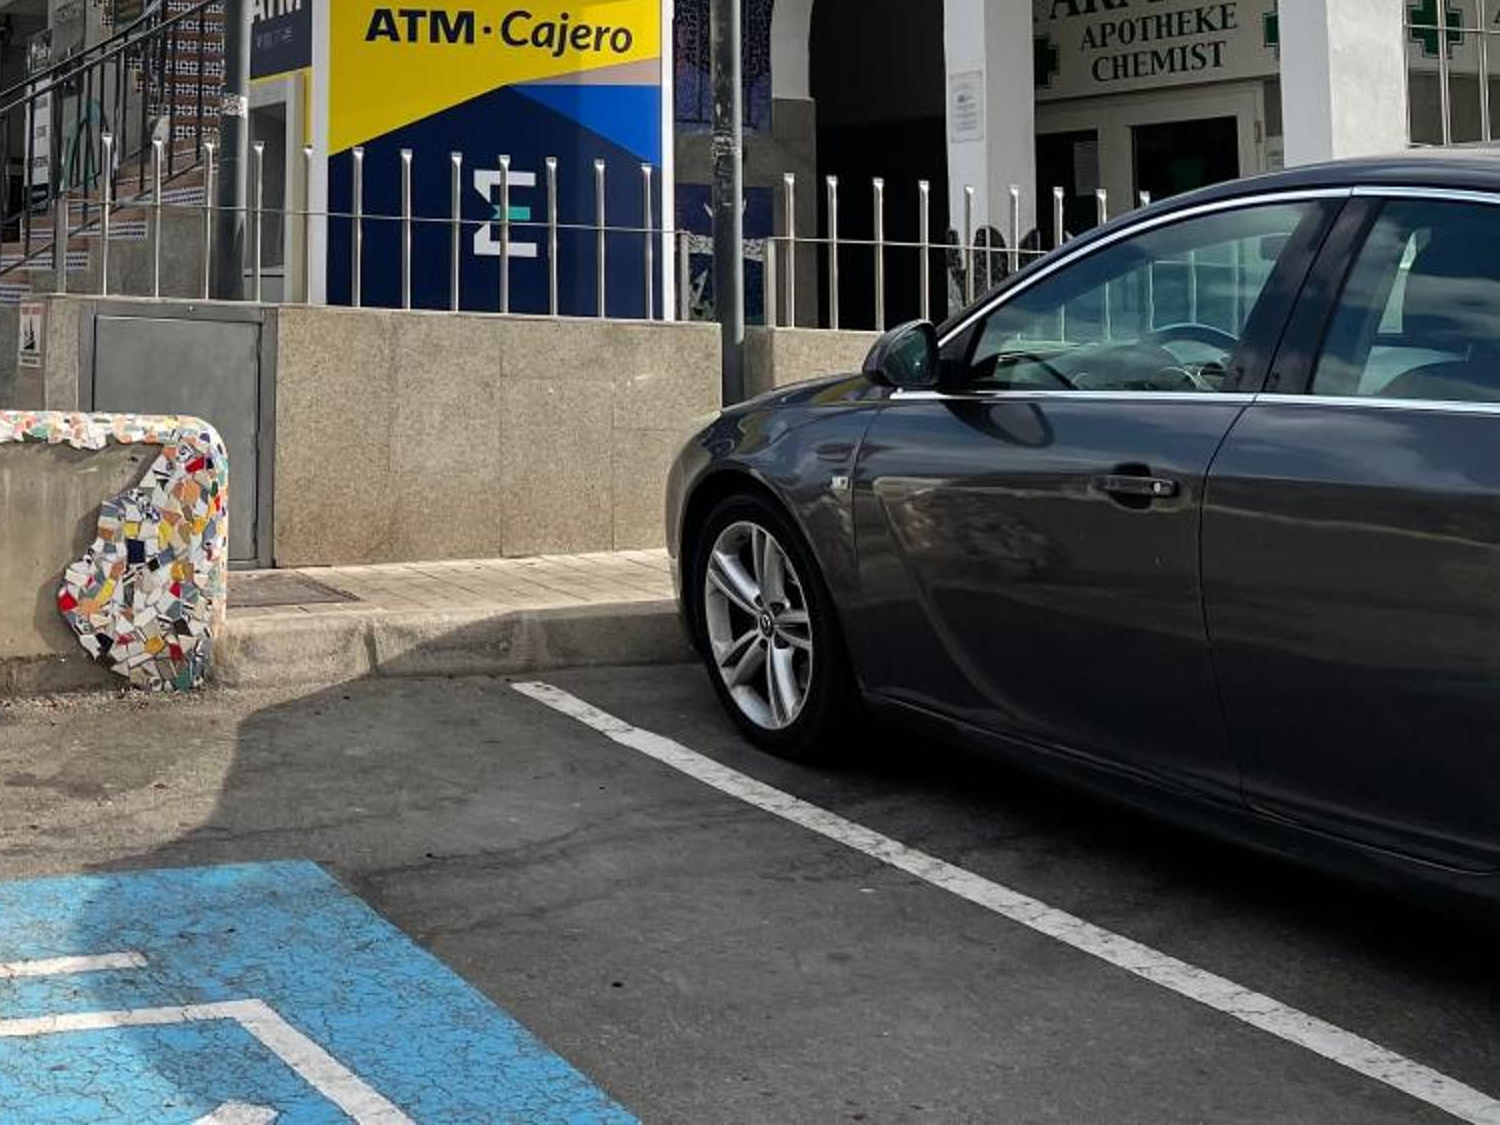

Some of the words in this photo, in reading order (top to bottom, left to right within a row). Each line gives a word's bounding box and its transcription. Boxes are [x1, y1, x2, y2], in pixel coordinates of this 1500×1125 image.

[365, 8, 475, 44] ATM
[500, 10, 633, 57] Cajero
[1080, 3, 1238, 52] APOTHEKE
[1092, 41, 1227, 82] CHEMIST
